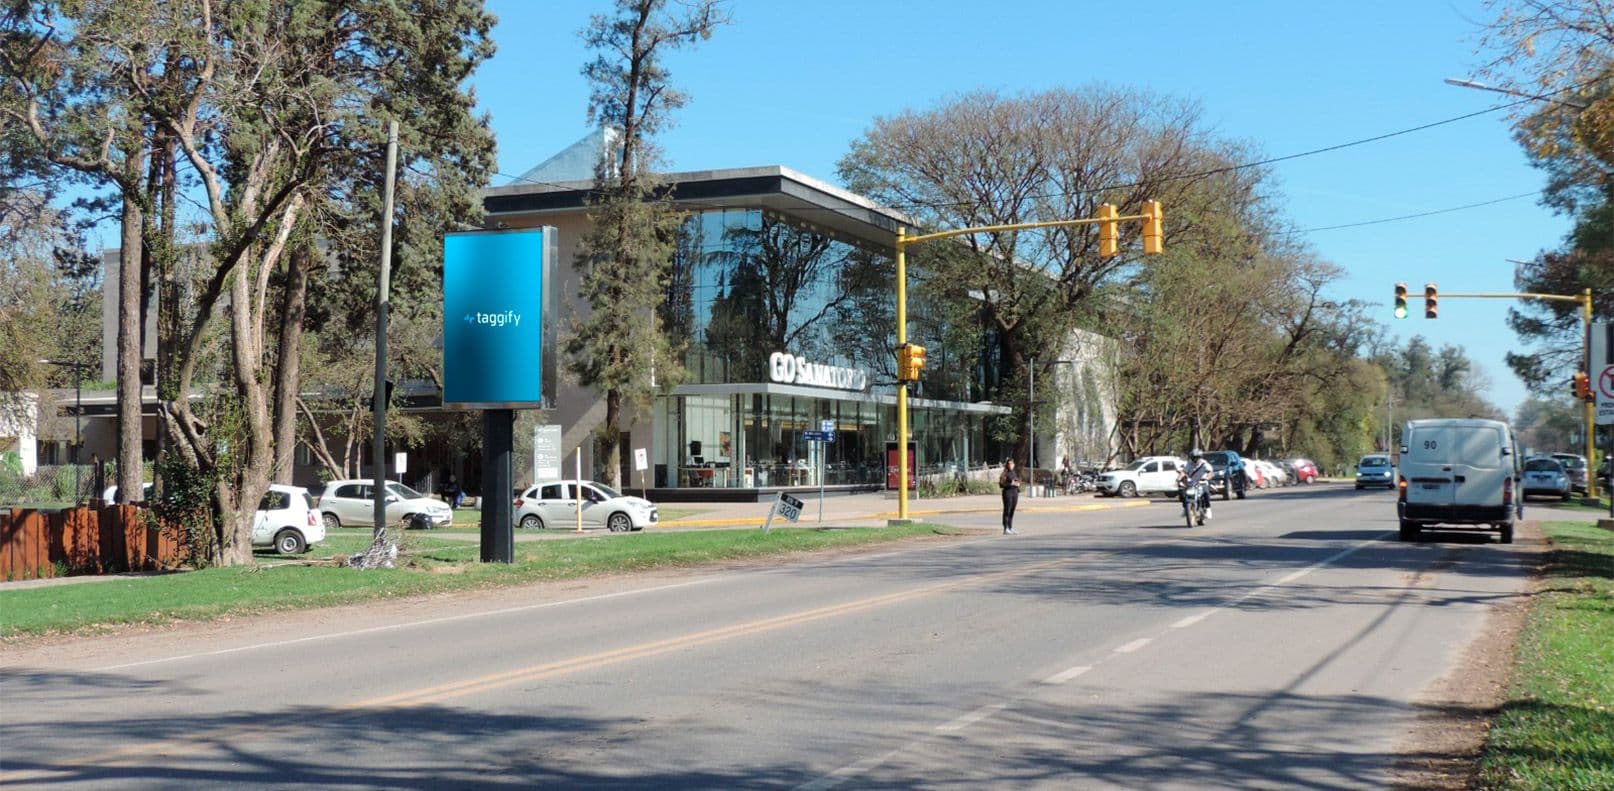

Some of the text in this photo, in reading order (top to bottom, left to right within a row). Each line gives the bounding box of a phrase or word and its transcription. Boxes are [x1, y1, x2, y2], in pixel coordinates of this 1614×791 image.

[476, 310, 520, 327] taggify
[769, 351, 795, 382] GO
[1423, 440, 1437, 450] 90
[779, 503, 798, 520] 320
